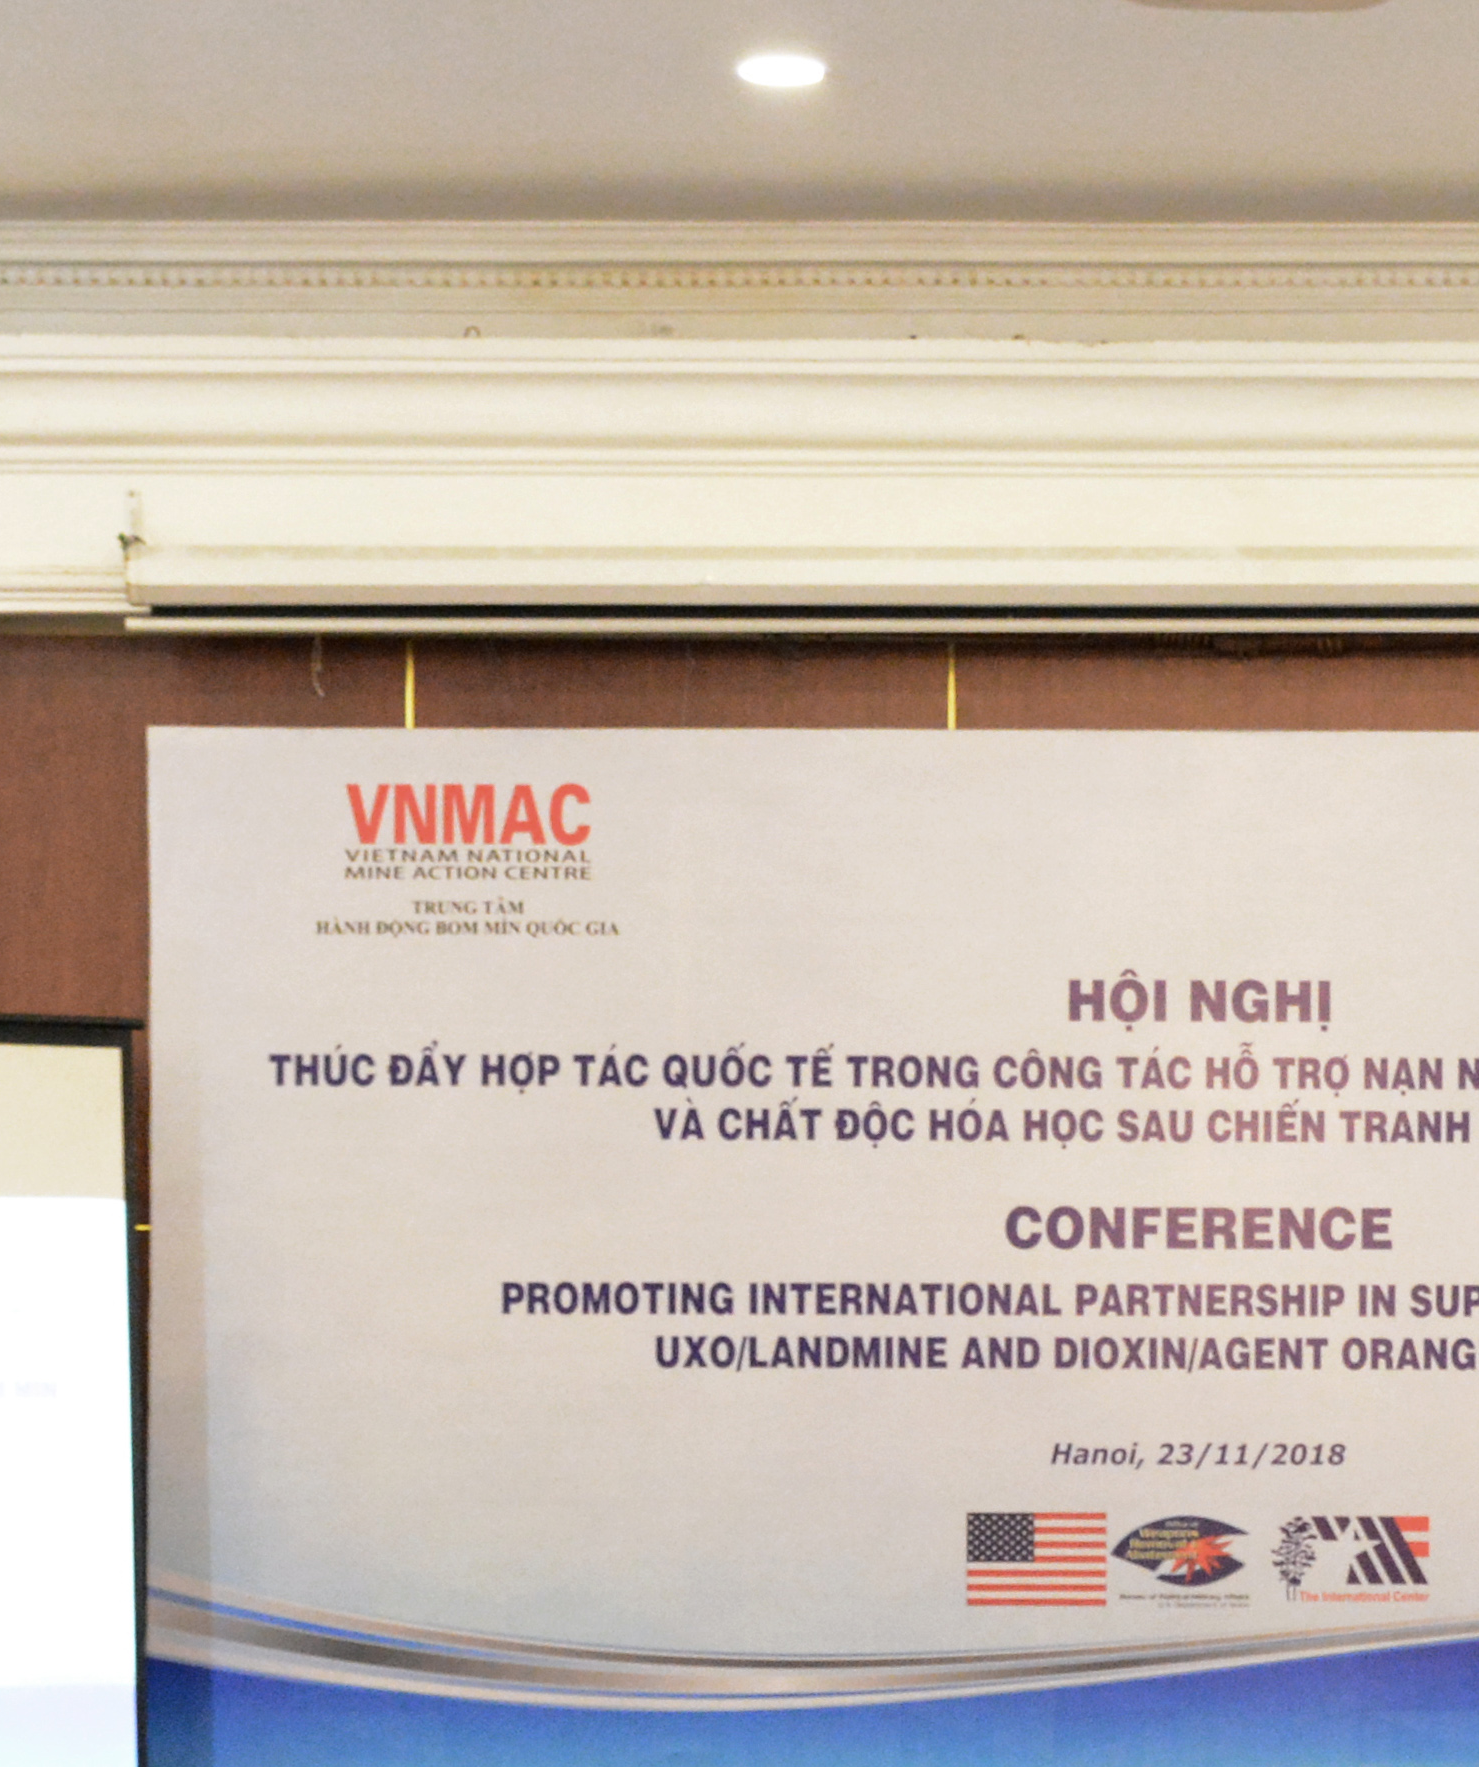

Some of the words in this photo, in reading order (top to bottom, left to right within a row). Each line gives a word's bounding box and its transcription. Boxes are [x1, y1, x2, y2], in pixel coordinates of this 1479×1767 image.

[346, 783, 591, 847] VNMAC
[344, 864, 403, 880] MINE
[413, 864, 498, 881] ACTION
[503, 865, 592, 881] CENTRE
[345, 848, 458, 863] VIETNAM
[467, 848, 589, 864] NATIONAL
[413, 900, 478, 915] TRUNG
[484, 896, 525, 915] TÂM
[315, 919, 371, 936] HÀNH
[375, 919, 430, 938] ĐỘNG
[435, 920, 479, 936] BOM
[484, 919, 521, 935] MÌN
[525, 919, 576, 938] QUỐC
[584, 921, 621, 937] GIA
[1067, 968, 1167, 1032] HỘI
[1189, 979, 1331, 1032] NGHỊ
[268, 1044, 375, 1088] THÚC
[386, 1040, 467, 1087] ĐẨY
[480, 1052, 561, 1095] HỢP
[572, 1043, 649, 1088] TÁC
[662, 1042, 772, 1089] QUỐC
[785, 1043, 834, 1088] TẾ
[845, 1054, 980, 1089] TRONG
[992, 1048, 1102, 1089] CÔNG
[1116, 1047, 1191, 1090] TÁC
[1206, 1042, 1259, 1089] HỖ
[1272, 1057, 1350, 1098] TRỢ
[1363, 1057, 1443, 1096] NẠN
[653, 1097, 705, 1141] VÀ
[717, 1096, 823, 1142] CHẤT
[834, 1100, 915, 1149] ĐỘC
[928, 1098, 1010, 1142] HÓA
[1023, 1108, 1104, 1149] HỌC
[1117, 1109, 1193, 1143] SAU
[1207, 1099, 1325, 1143] CHIẾN
[1339, 1110, 1470, 1143] TRANH
[1004, 1205, 1393, 1251] CONFERENCE
[501, 1280, 734, 1316] PROMOTING
[749, 1281, 1062, 1317] INTERNATIONAL
[1075, 1283, 1345, 1318] PARTNERSHIP
[1358, 1284, 1396, 1317] IN
[655, 1334, 948, 1372] UXO/LANDMINE
[961, 1336, 1041, 1369] AND
[1054, 1336, 1329, 1373] DIOXIN/AGENT
[1051, 1442, 1144, 1469] Hanoi,
[1157, 1442, 1346, 1470] 23/11/2018
[1301, 1591, 1319, 1602] The
[1323, 1591, 1389, 1602] International
[1394, 1591, 1430, 1602] Center
